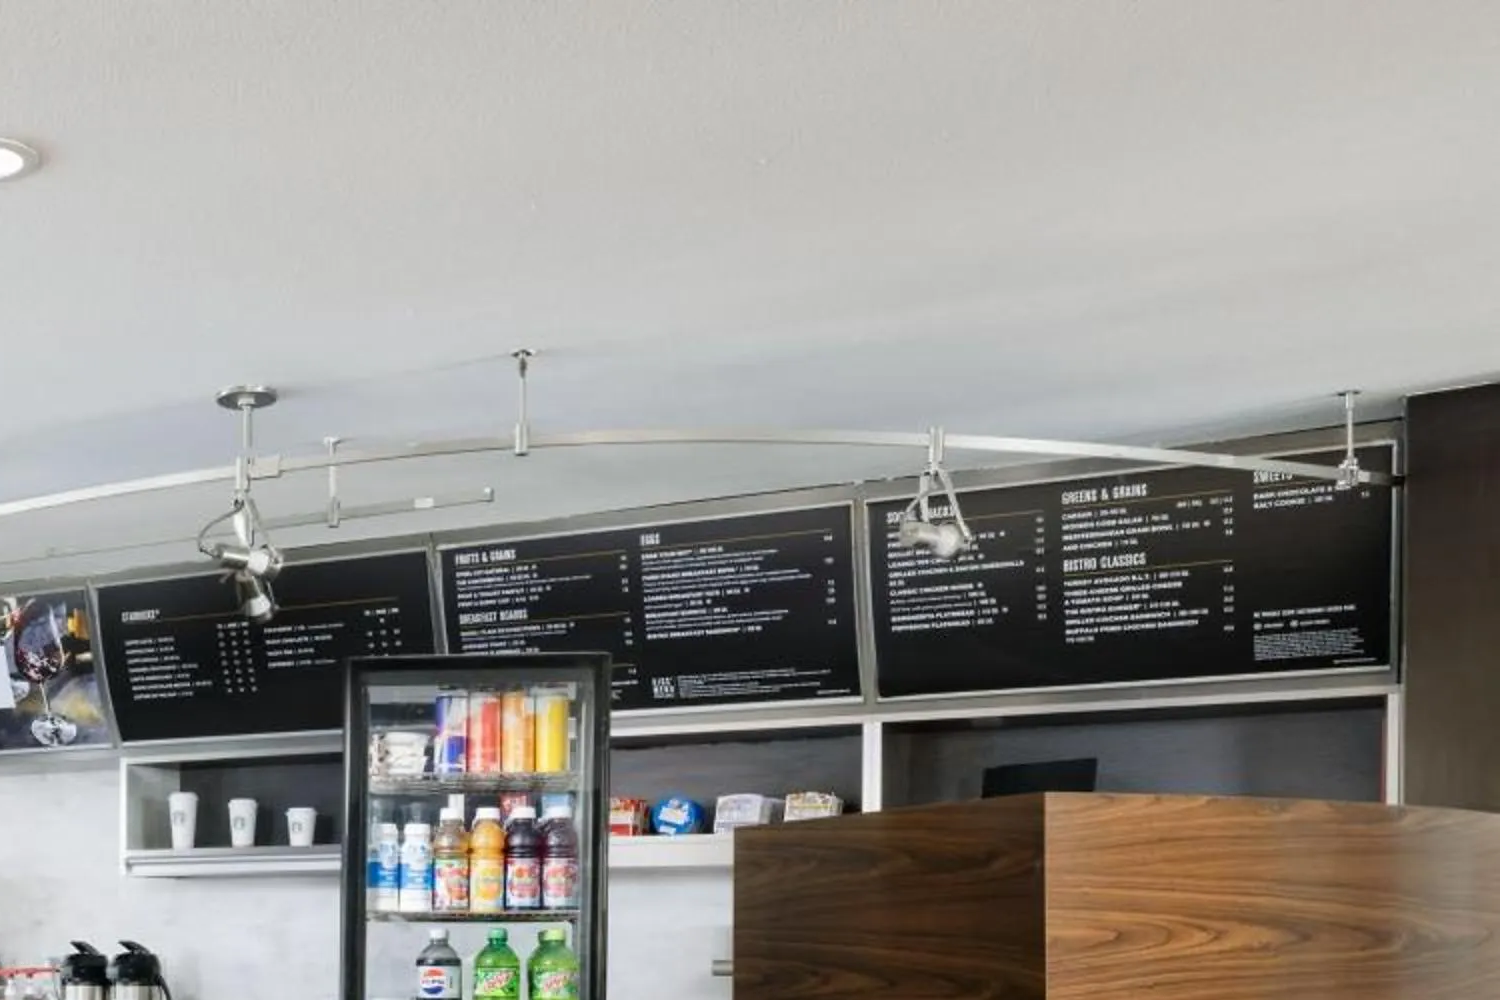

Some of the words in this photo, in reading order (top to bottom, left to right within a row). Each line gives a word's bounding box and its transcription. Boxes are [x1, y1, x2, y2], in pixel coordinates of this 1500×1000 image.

[1061, 488, 1098, 505] GREENS
[1101, 487, 1109, 501] &
[1113, 483, 1148, 499] GRAINS
[1063, 557, 1098, 572] BISTRO
[1100, 552, 1147, 569] CLASSICS
